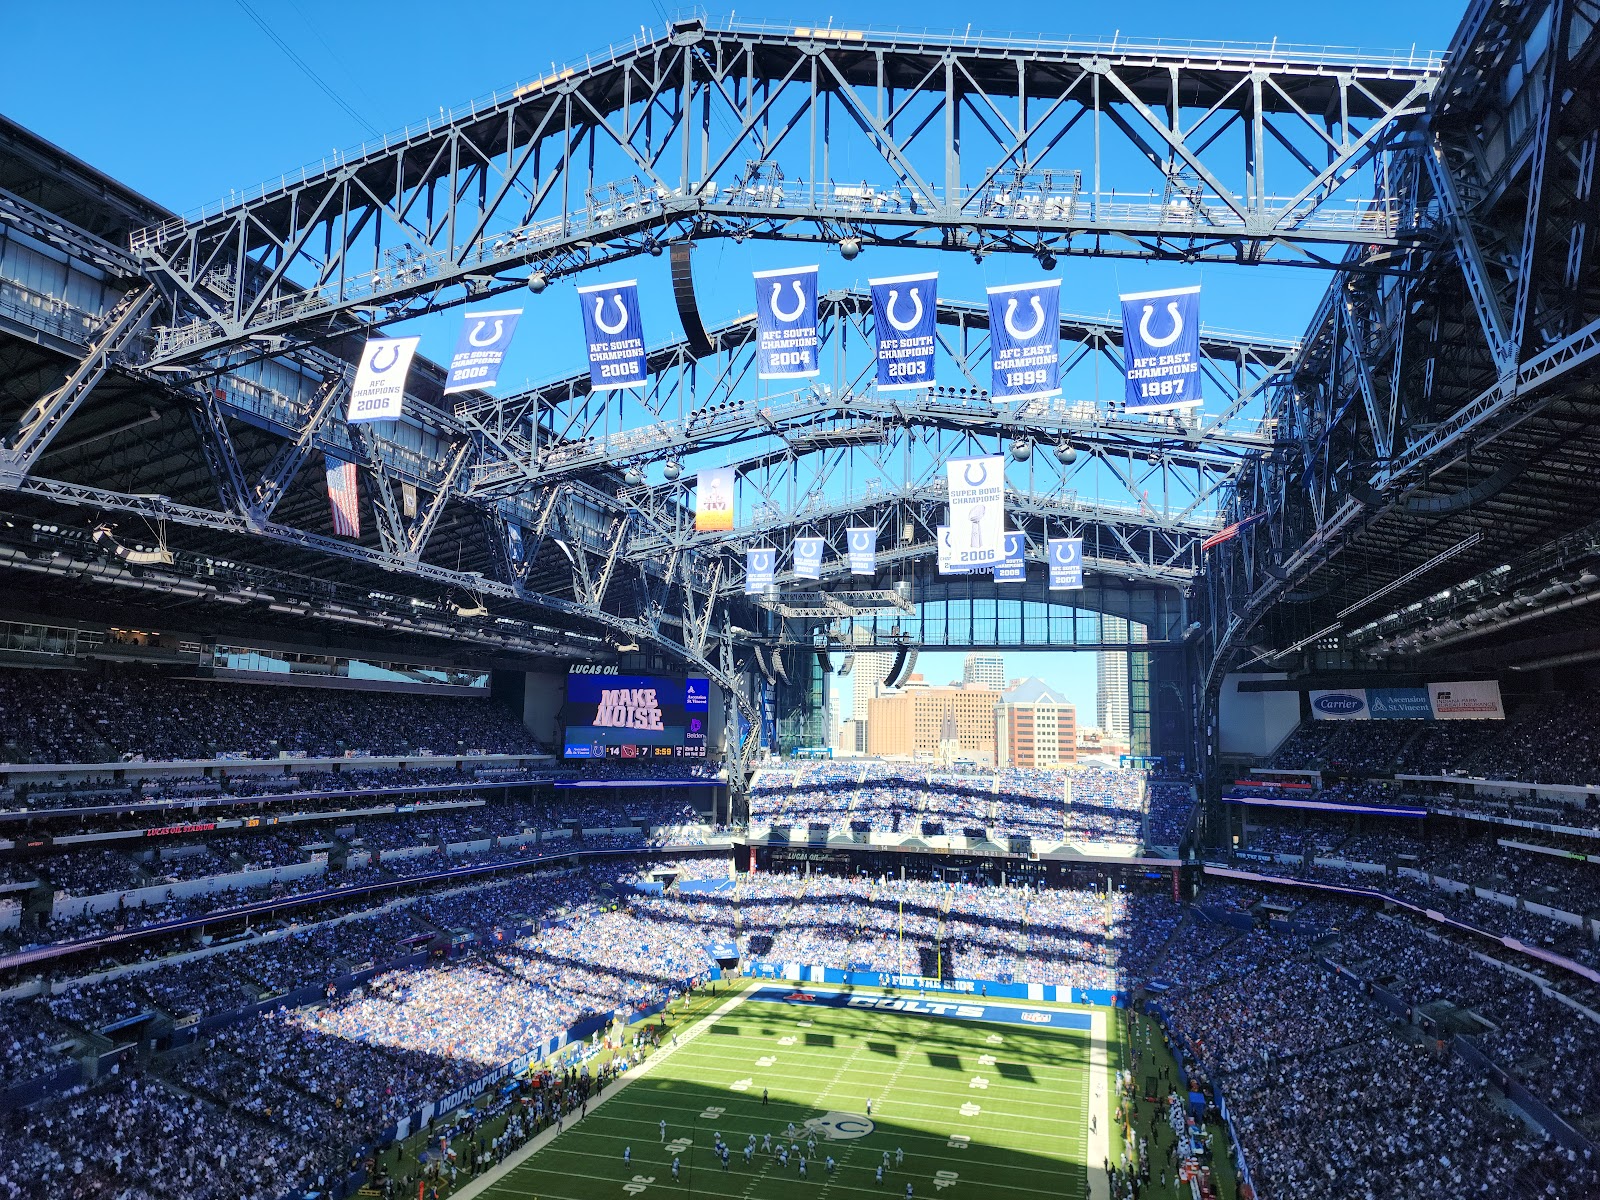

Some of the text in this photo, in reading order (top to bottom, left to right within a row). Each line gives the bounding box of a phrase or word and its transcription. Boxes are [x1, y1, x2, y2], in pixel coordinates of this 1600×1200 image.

[763, 327, 816, 340] AFC SOUTH
[590, 338, 642, 353] AFC SOUTH
[761, 337, 818, 350] CHAMPIONS
[880, 336, 934, 350] AFC SOUTH
[453, 351, 503, 361] AFC SOUTH
[589, 347, 645, 362] CHAMPIONS
[770, 351, 811, 366] 2004
[879, 346, 935, 360] CHAMPIONS
[999, 344, 1053, 360] AFC EAST
[450, 357, 502, 370] CHAMPIONS
[993, 354, 1058, 371] CHAMPIONS
[1133, 353, 1191, 369] AFC EAST
[452, 366, 489, 381] 2006
[600, 362, 640, 378] 2005
[888, 361, 926, 377] 2003
[1127, 362, 1198, 380] CHAMPIONS
[369, 379, 386, 388] AFC
[1006, 369, 1047, 388] 1999
[353, 386, 401, 398] CHAMPIONS
[1141, 379, 1185, 398] 1987
[357, 398, 390, 412] 2006
[950, 486, 1003, 498] SUPER BOWL
[952, 494, 1000, 505] CHAMPIONS
[960, 549, 995, 562] 2006
[1055, 576, 1077, 584] 2007
[569, 664, 619, 676] LUCAS OIL
[600, 688, 658, 709] MAKE
[1320, 699, 1358, 709] Carrier
[1388, 696, 1426, 704] Ascension
[592, 703, 664, 731] NOISE
[610, 747, 620, 755] 14
[642, 747, 648, 755] 7
[654, 747, 672, 756] 3:59
[147, 824, 215, 837] LUCAS OIL STADIUM
[892, 975, 975, 991] FOR THE SHOE
[846, 996, 986, 1018] COLTS
[439, 1047, 539, 1116] INDIANAPOLIS COLTS
[700, 1106, 726, 1119] 50
[947, 1134, 971, 1149] 50
[622, 1175, 656, 1192] 30
[933, 1170, 959, 1188] 40
